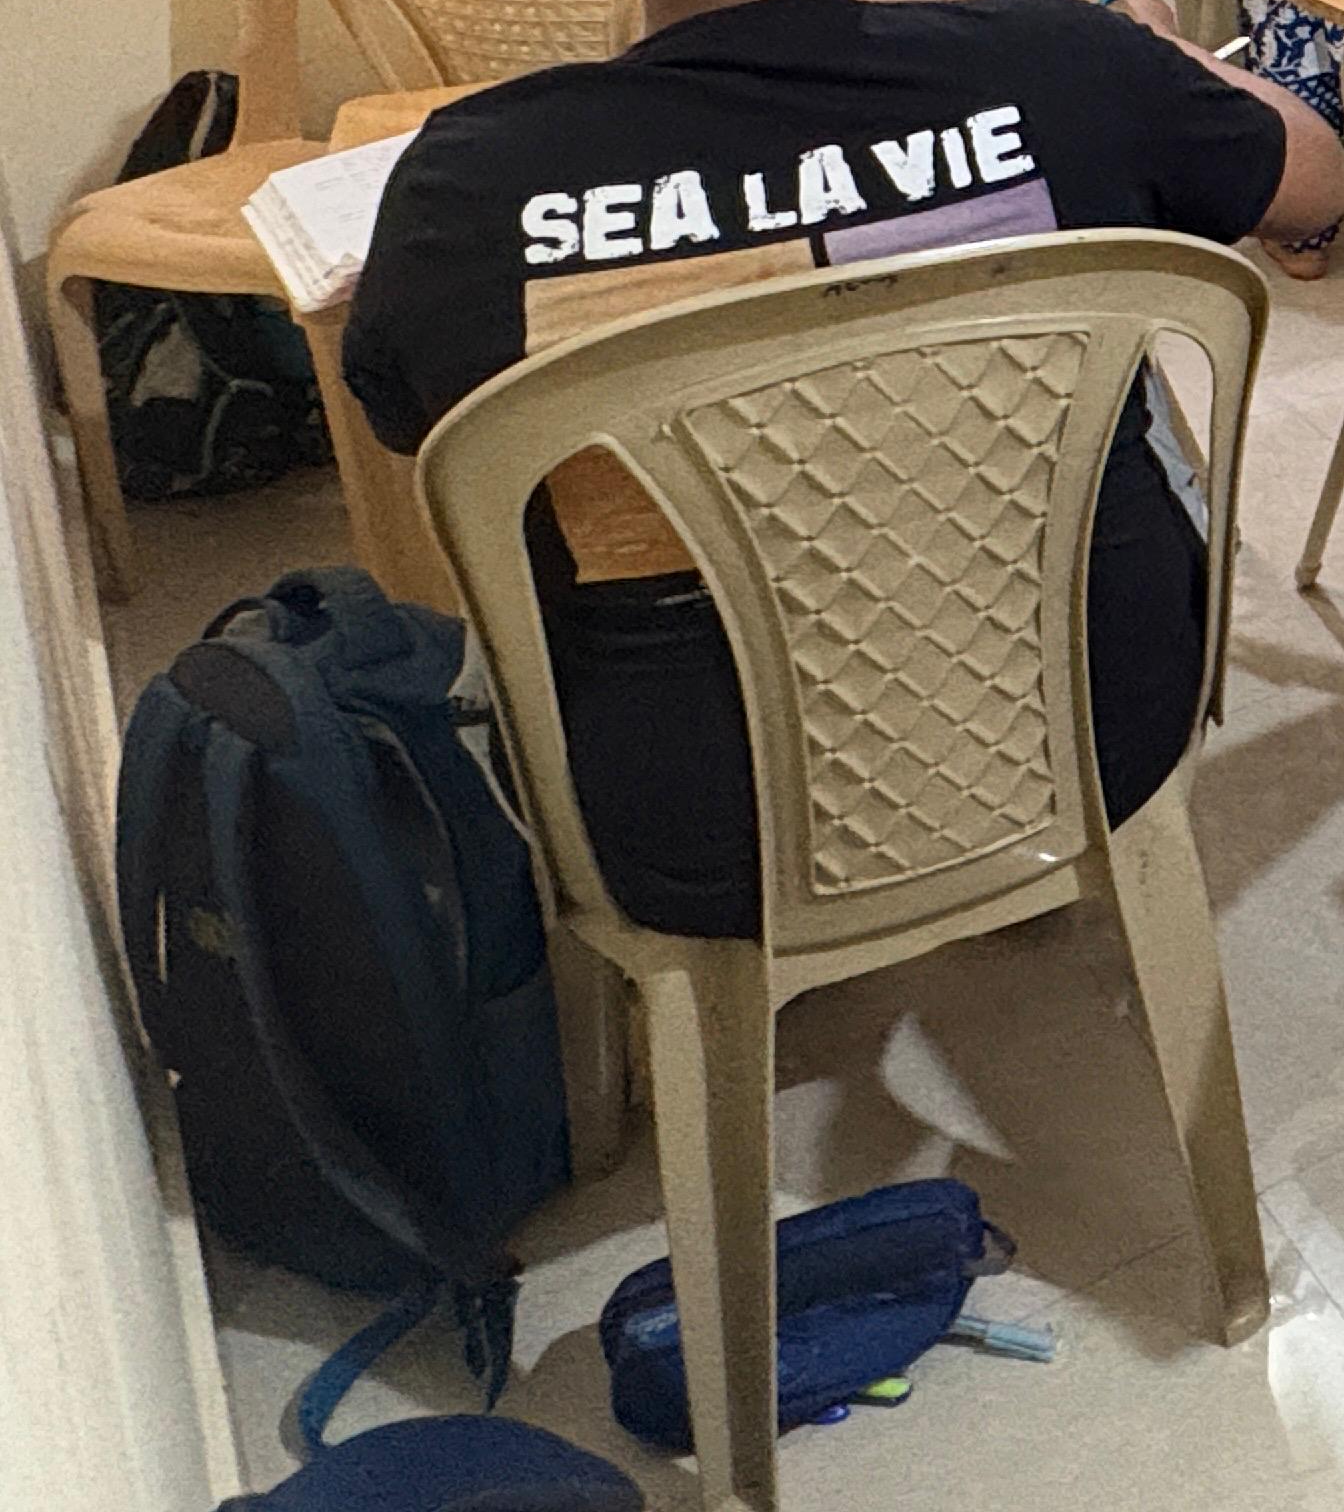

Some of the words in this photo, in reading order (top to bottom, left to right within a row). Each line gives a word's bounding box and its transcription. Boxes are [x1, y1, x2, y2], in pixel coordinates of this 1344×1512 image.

[521, 170, 720, 264] SEA
[743, 144, 868, 232] LA
[871, 105, 1036, 202] VIE
